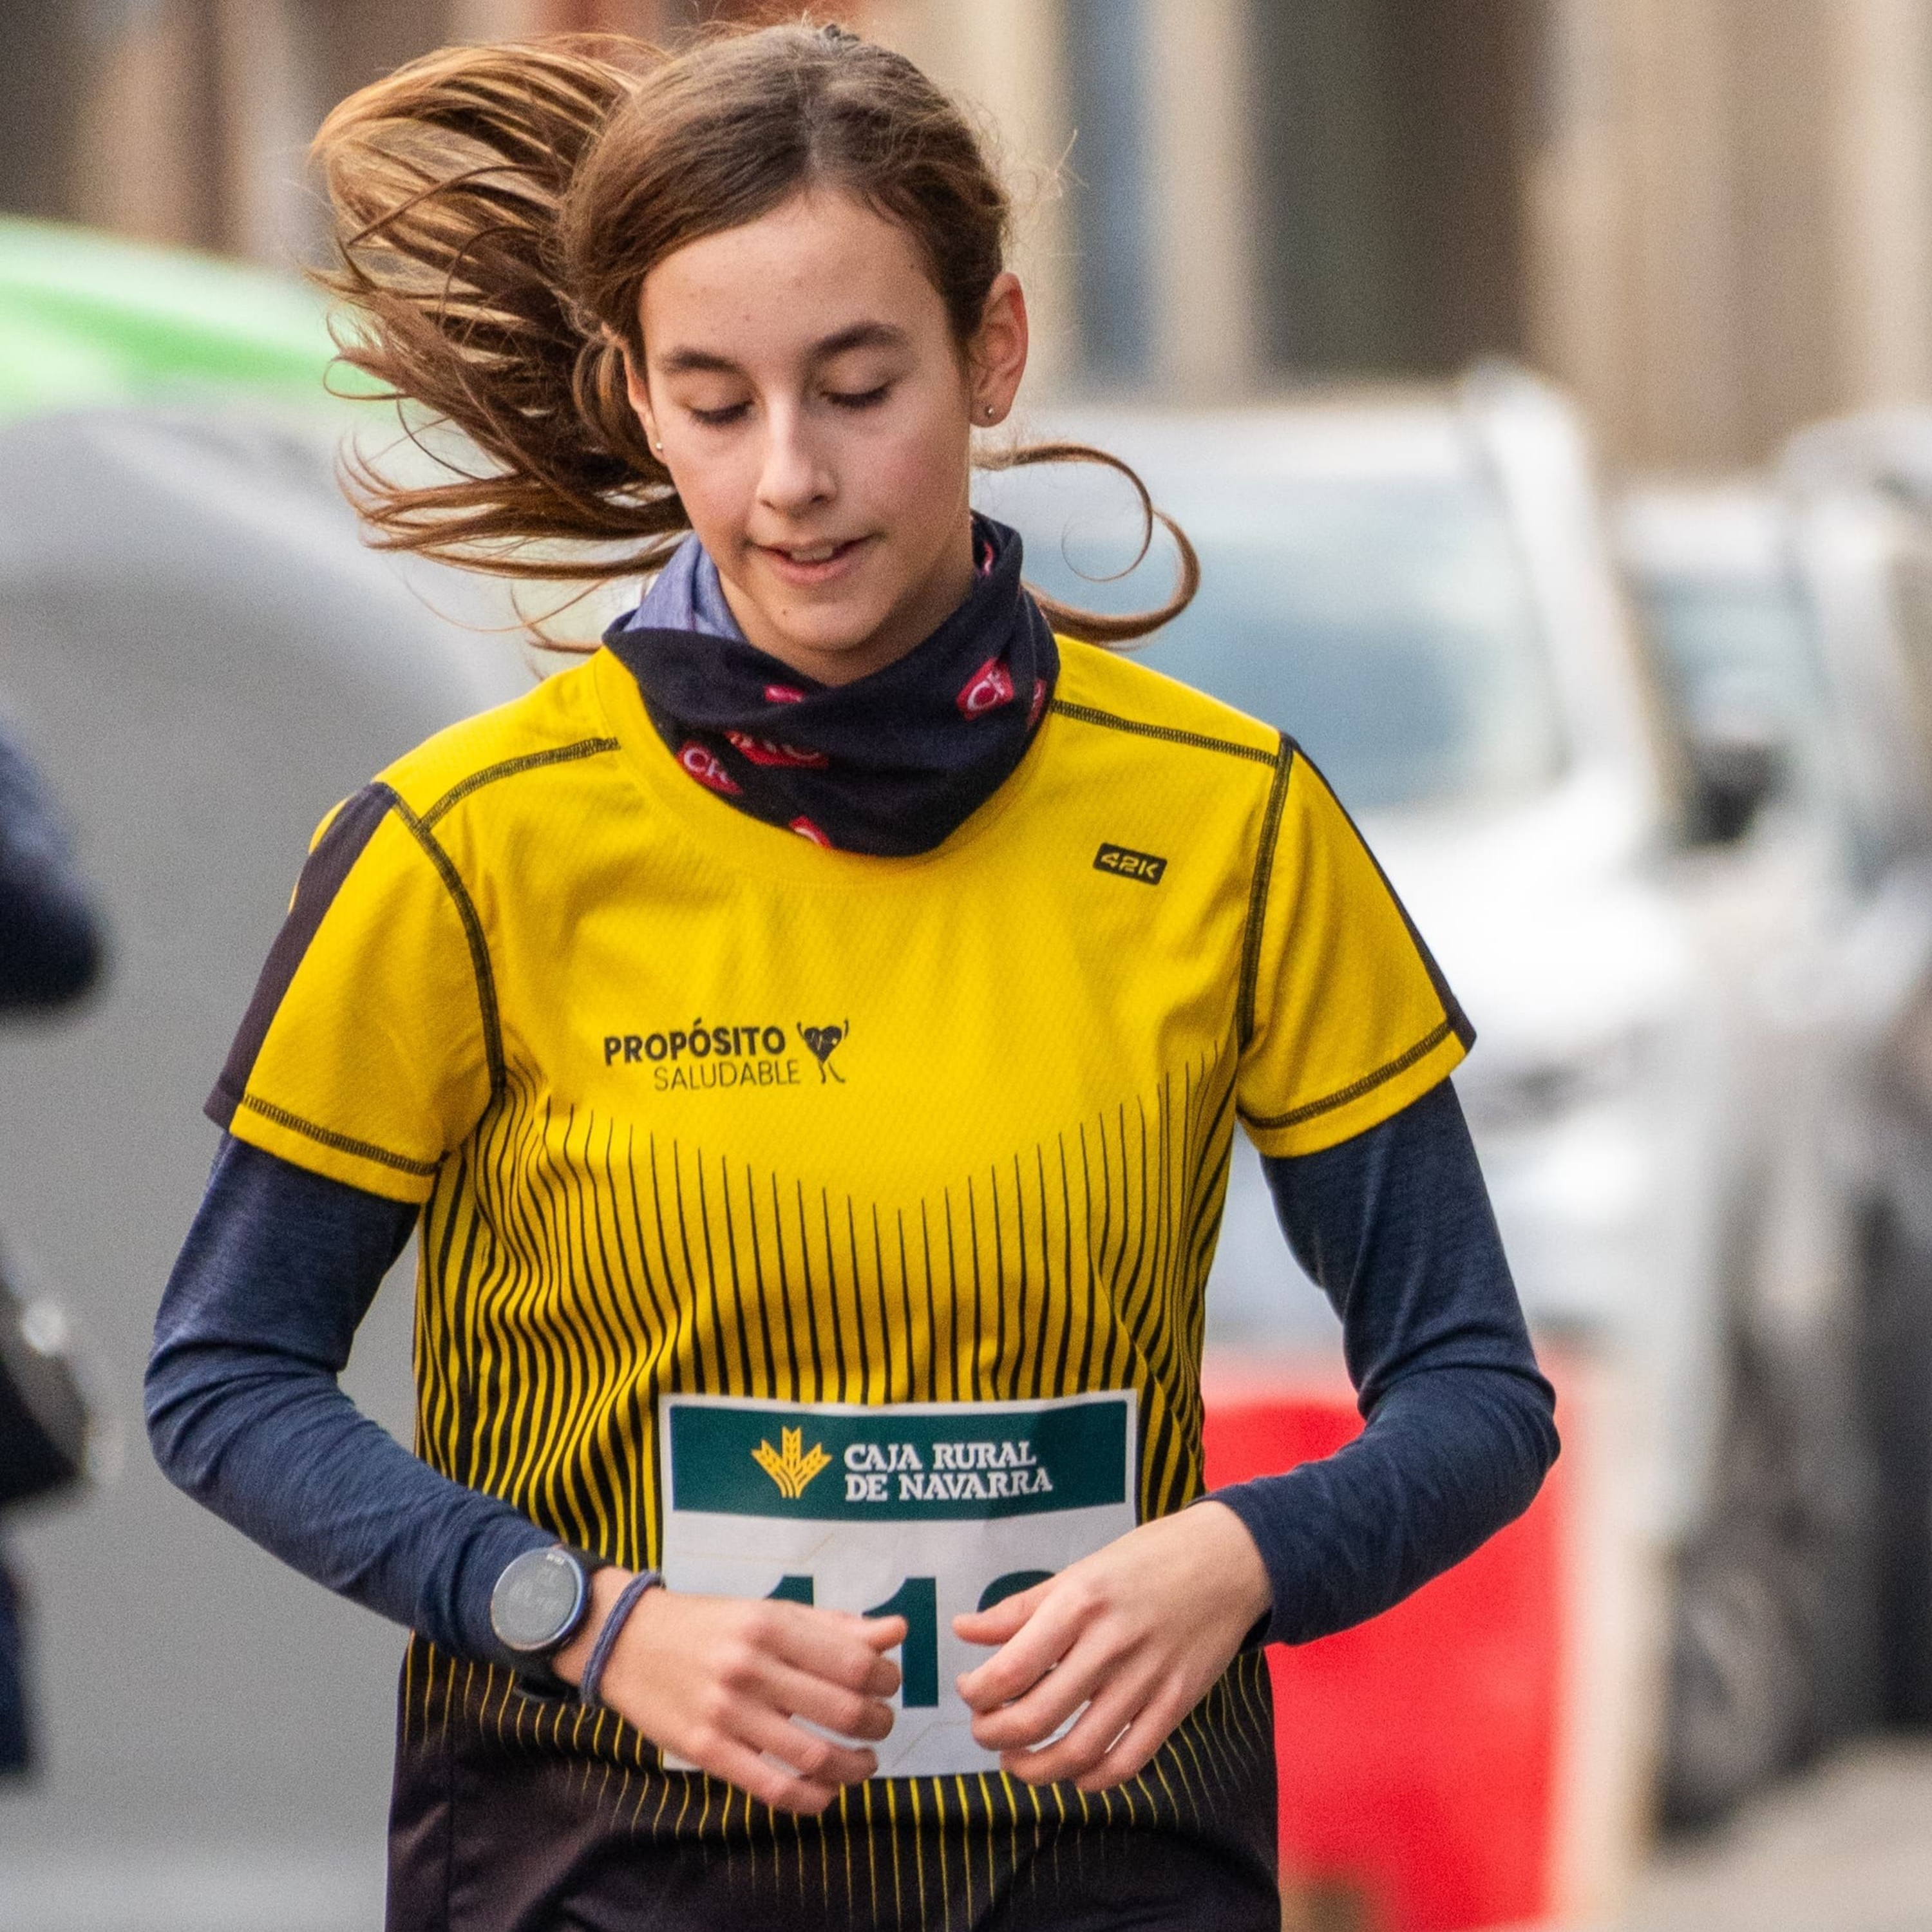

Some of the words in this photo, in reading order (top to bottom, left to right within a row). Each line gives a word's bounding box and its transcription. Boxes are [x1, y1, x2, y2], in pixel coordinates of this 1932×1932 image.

[1101, 851, 1159, 878] 42K
[604, 1018, 786, 1066] PROPÓSITO
[654, 1059, 800, 1092] SALUDABLE
[844, 1443, 923, 1473] CAJA
[933, 1441, 1037, 1470] RURAL
[845, 1473, 888, 1502] DE
[898, 1467, 1054, 1501] NAVARRA
